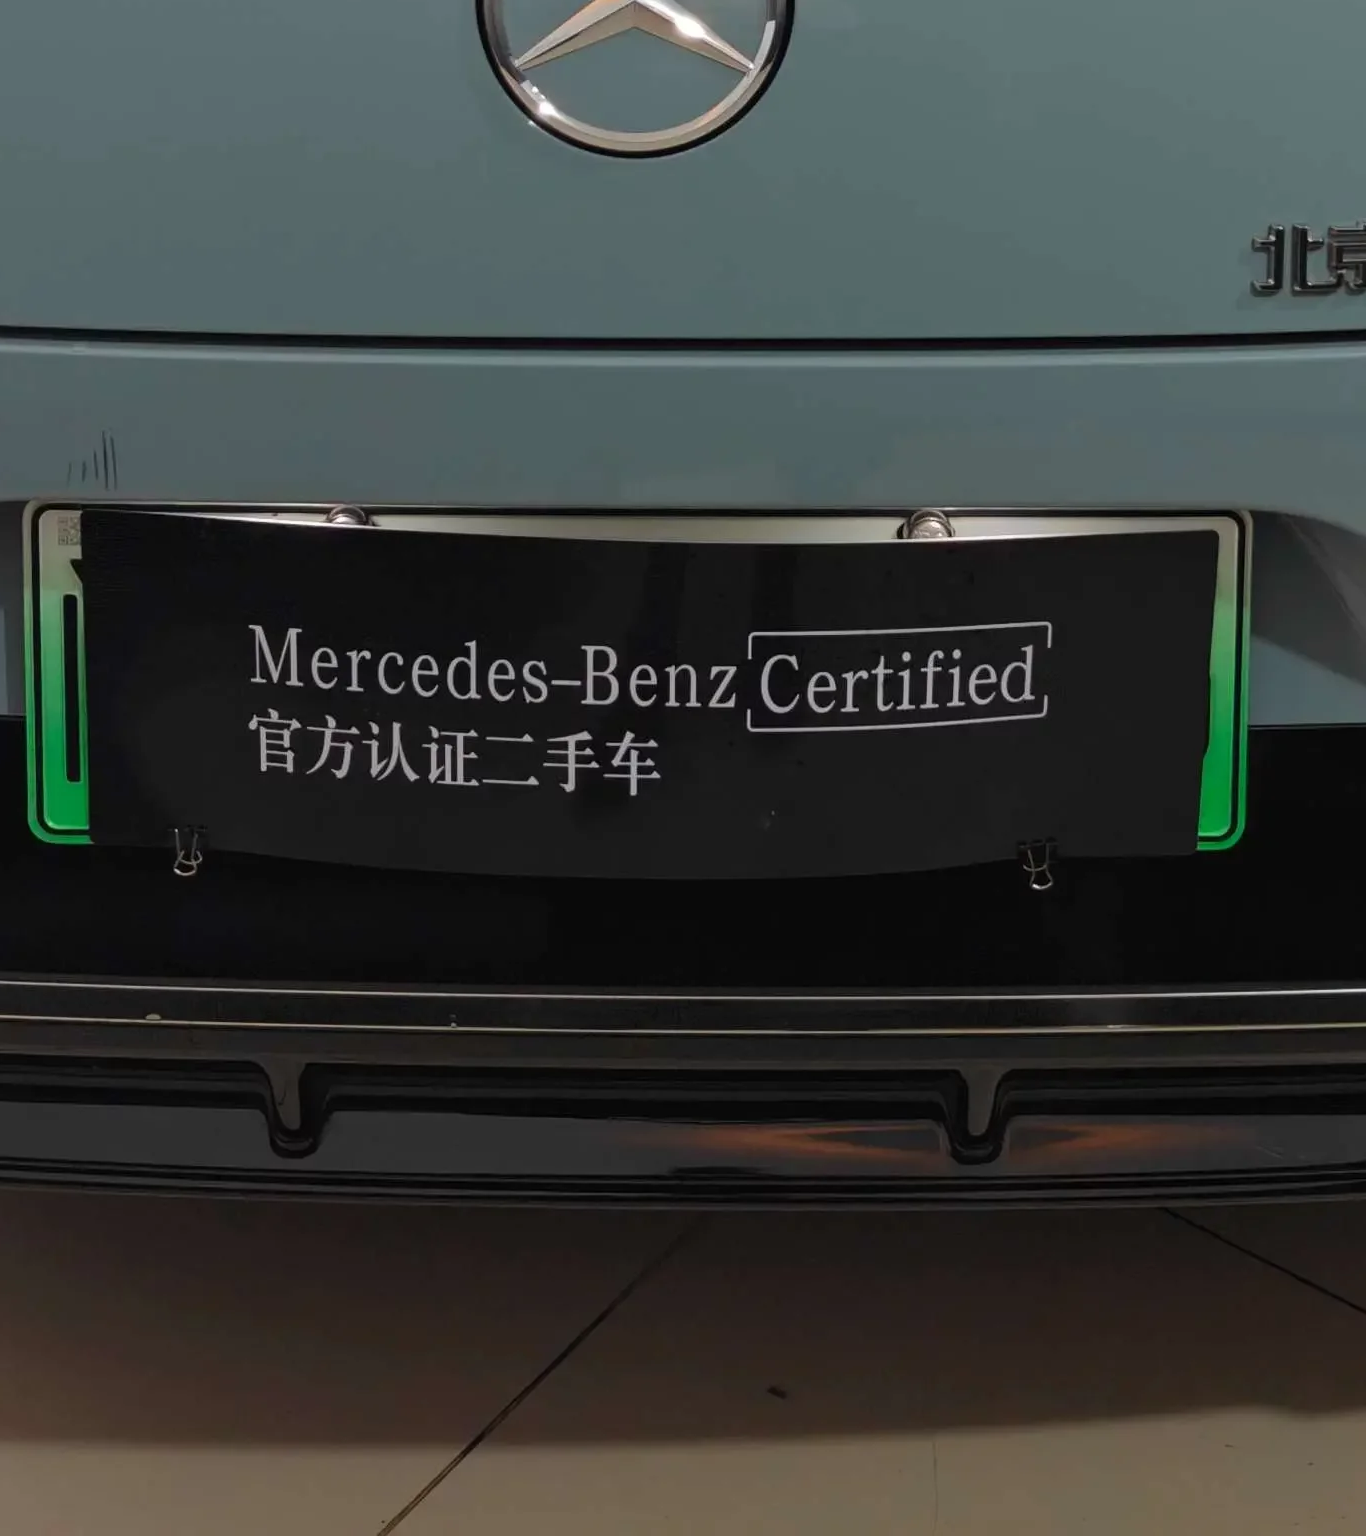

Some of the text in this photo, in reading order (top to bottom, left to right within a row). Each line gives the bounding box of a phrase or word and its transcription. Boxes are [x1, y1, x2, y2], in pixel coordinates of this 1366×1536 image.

[248, 624, 1036, 714] Mercedes-Benz Certified
[248, 708, 661, 796] 官方认证二手车
